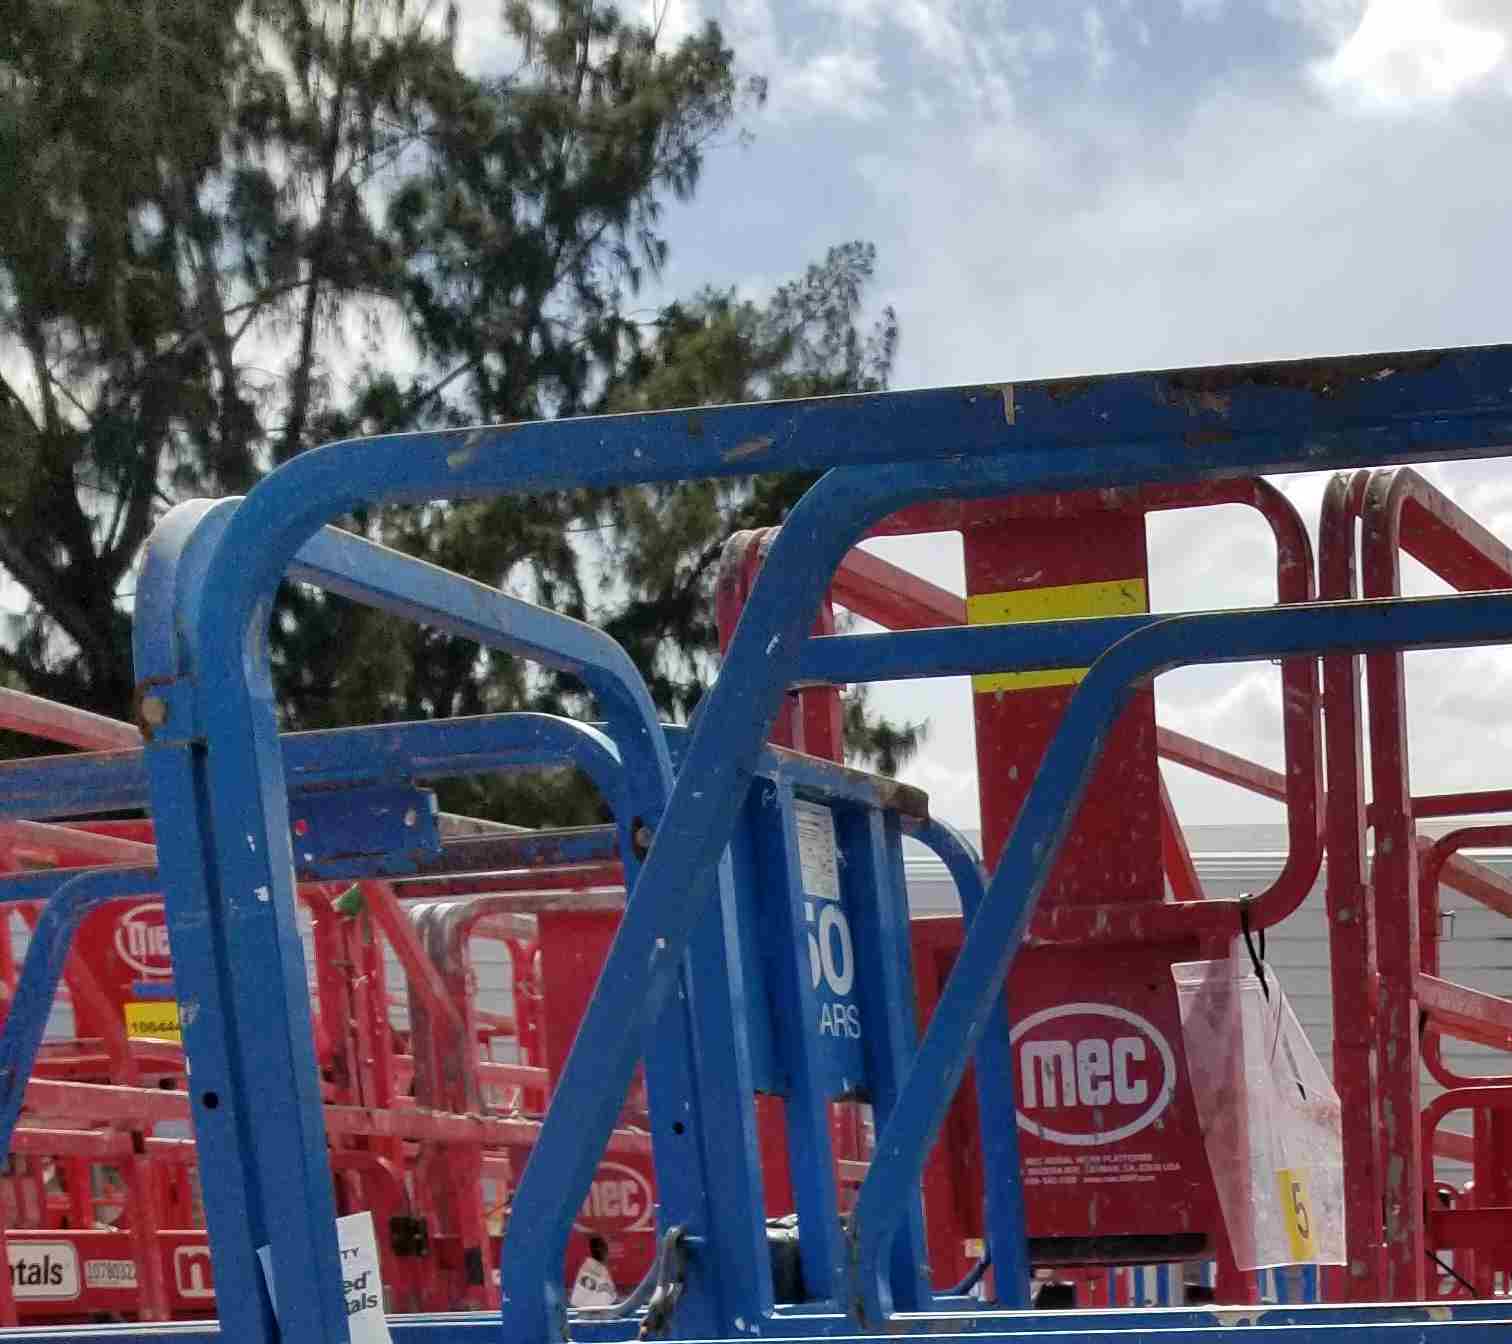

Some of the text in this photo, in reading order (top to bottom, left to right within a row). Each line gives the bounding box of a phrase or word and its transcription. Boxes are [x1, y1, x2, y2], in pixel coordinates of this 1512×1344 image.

[127, 923, 171, 956] me
[819, 1003, 862, 1039] ARS
[1020, 1037, 1148, 1108] mec
